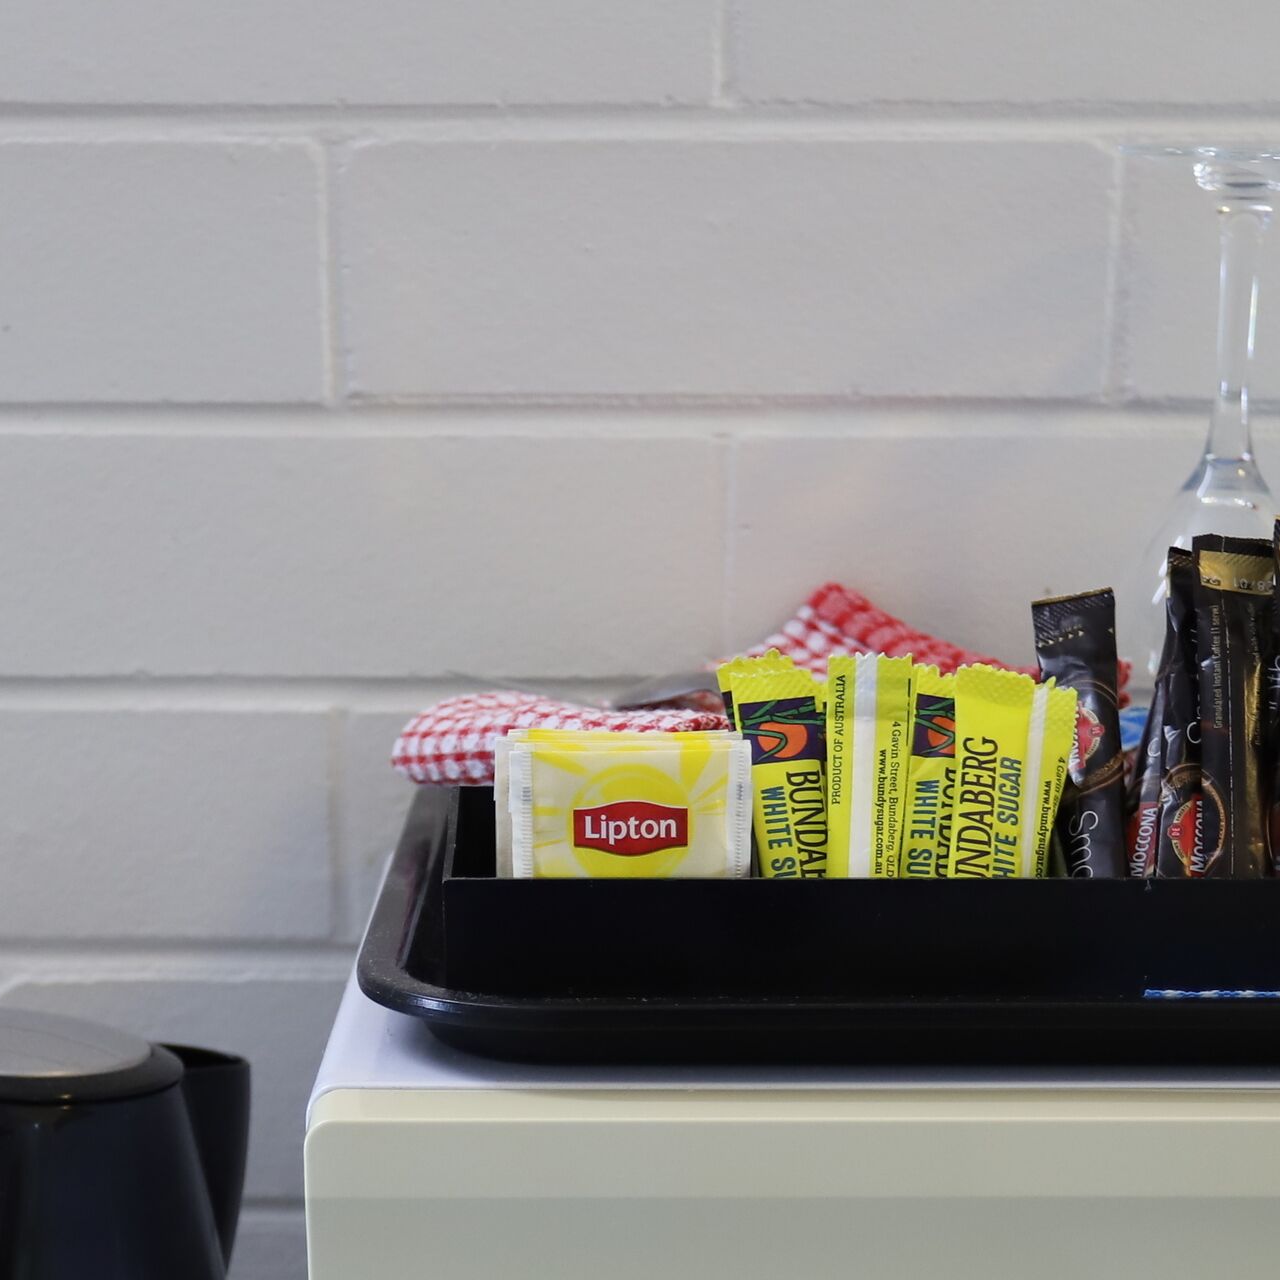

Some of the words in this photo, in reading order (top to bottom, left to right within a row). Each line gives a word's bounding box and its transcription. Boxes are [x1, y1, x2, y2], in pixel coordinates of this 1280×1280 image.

[834, 674, 847, 737] AUSTRALIA
[833, 738, 845, 753] OF
[891, 729, 901, 759] Gavin
[831, 754, 844, 805] PRODUCT
[888, 761, 900, 795] Street,
[996, 757, 1021, 826] SUGAR
[584, 814, 677, 846] Lipton
[761, 786, 793, 850] WHITE
[874, 749, 887, 875] www.bundysugar.com.au
[887, 796, 899, 853] Bundaberg,
[910, 779, 940, 840] WHITE
[1129, 806, 1157, 877] MOCCONA
